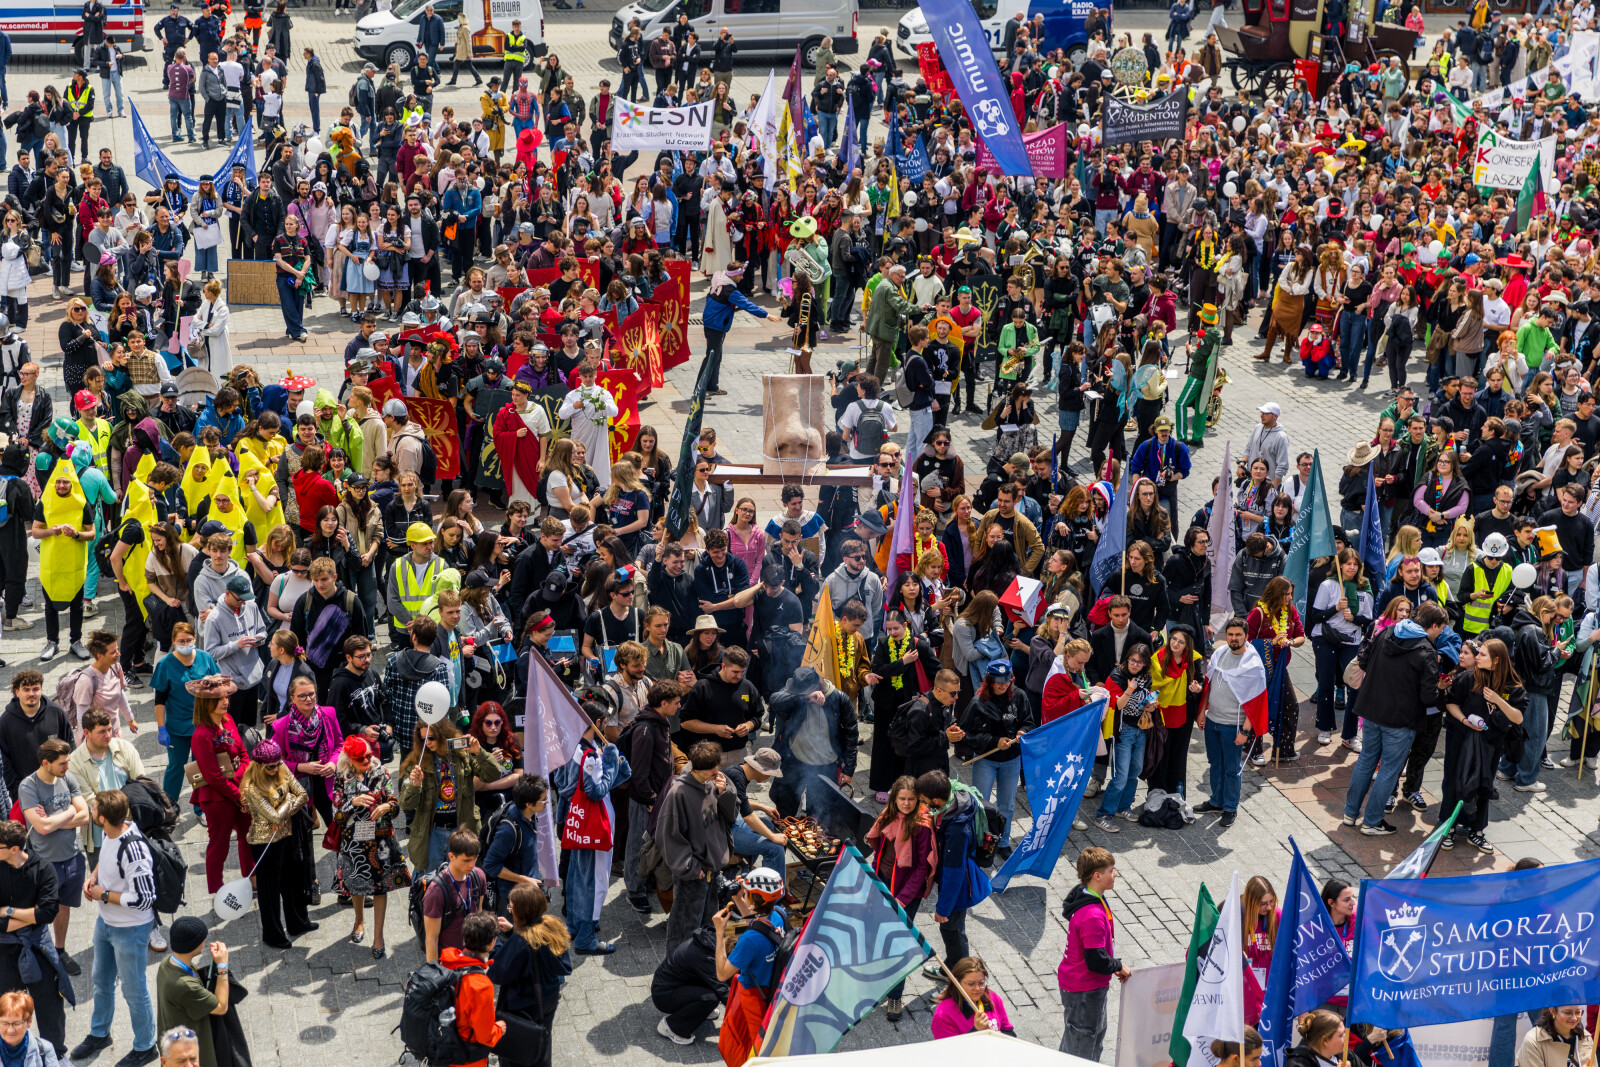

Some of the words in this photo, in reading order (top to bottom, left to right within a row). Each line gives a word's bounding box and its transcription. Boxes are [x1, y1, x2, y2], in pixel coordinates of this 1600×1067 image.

[492, 1, 521, 12] BROWAR
[649, 105, 708, 127] ESN
[1474, 165, 1525, 187] FLASZK
[569, 802, 585, 819] idę
[567, 816, 580, 828] do
[566, 829, 590, 844] kina
[1432, 911, 1595, 947] SAMORZĄD
[1430, 937, 1592, 976] STUDENTÓW
[1371, 981, 1472, 1002] UNIWERSYTETU
[1476, 965, 1588, 996] JAGIELLOŃSKIEGO
